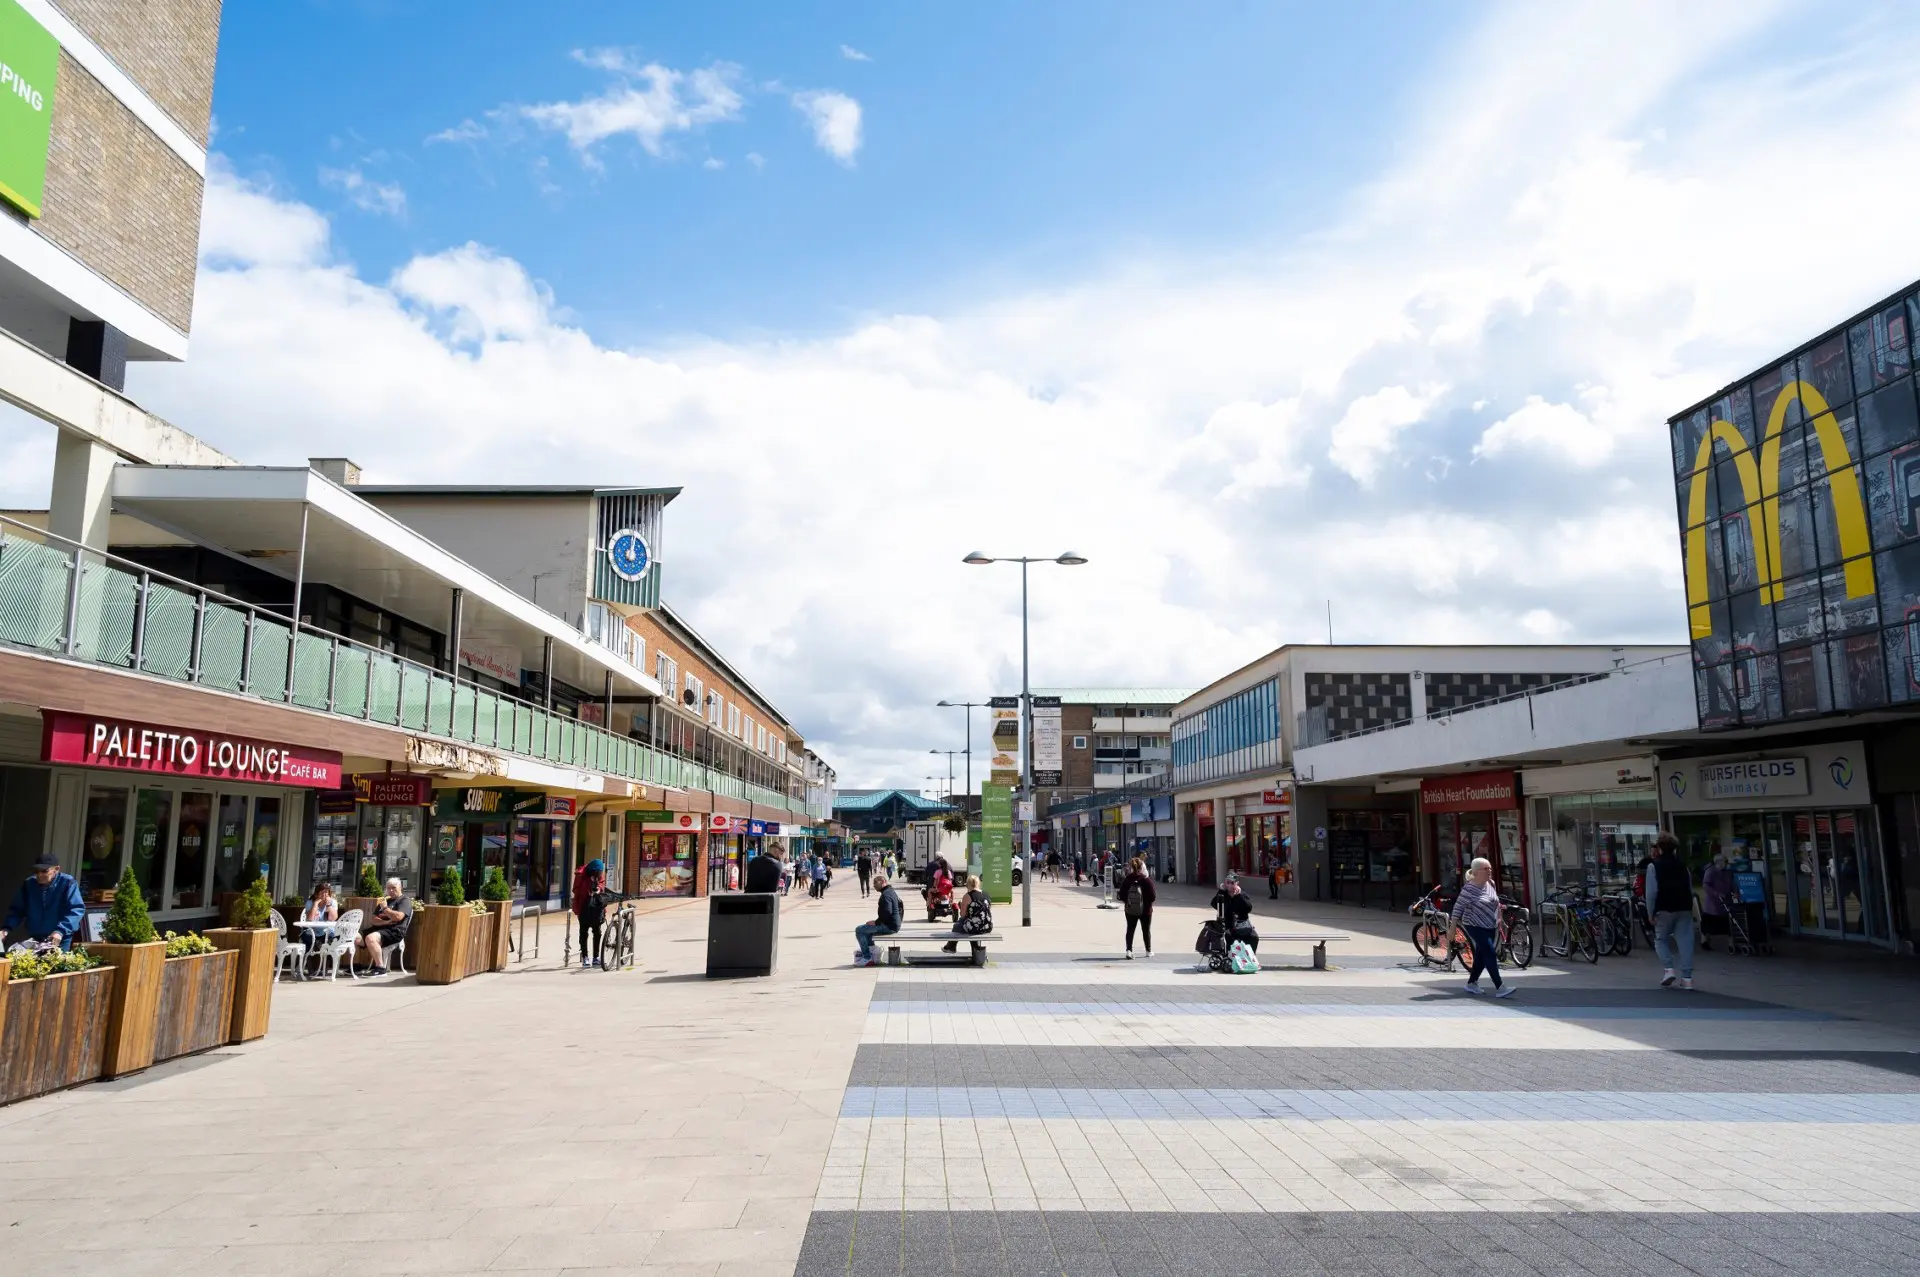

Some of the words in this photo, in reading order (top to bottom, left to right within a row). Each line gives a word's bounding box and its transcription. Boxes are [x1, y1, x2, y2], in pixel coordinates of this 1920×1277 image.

[0, 61, 44, 112] PING
[92, 723, 198, 765] PALETTO
[207, 739, 289, 776] LOUNGE
[290, 763, 311, 779] CAFÉ
[313, 766, 327, 780] BAR
[1700, 761, 1796, 782] THURSFIELDS
[374, 793, 415, 801] LOUNGE
[375, 784, 415, 792] PALETTO
[1424, 790, 1445, 804] British
[1445, 788, 1465, 802] Heart
[1466, 784, 1511, 801] Foundation
[1712, 782, 1768, 796] pharmacy
[464, 788, 501, 812] SUBWAY
[513, 795, 543, 811] SUBWAY
[143, 831, 157, 846] CAFÉ
